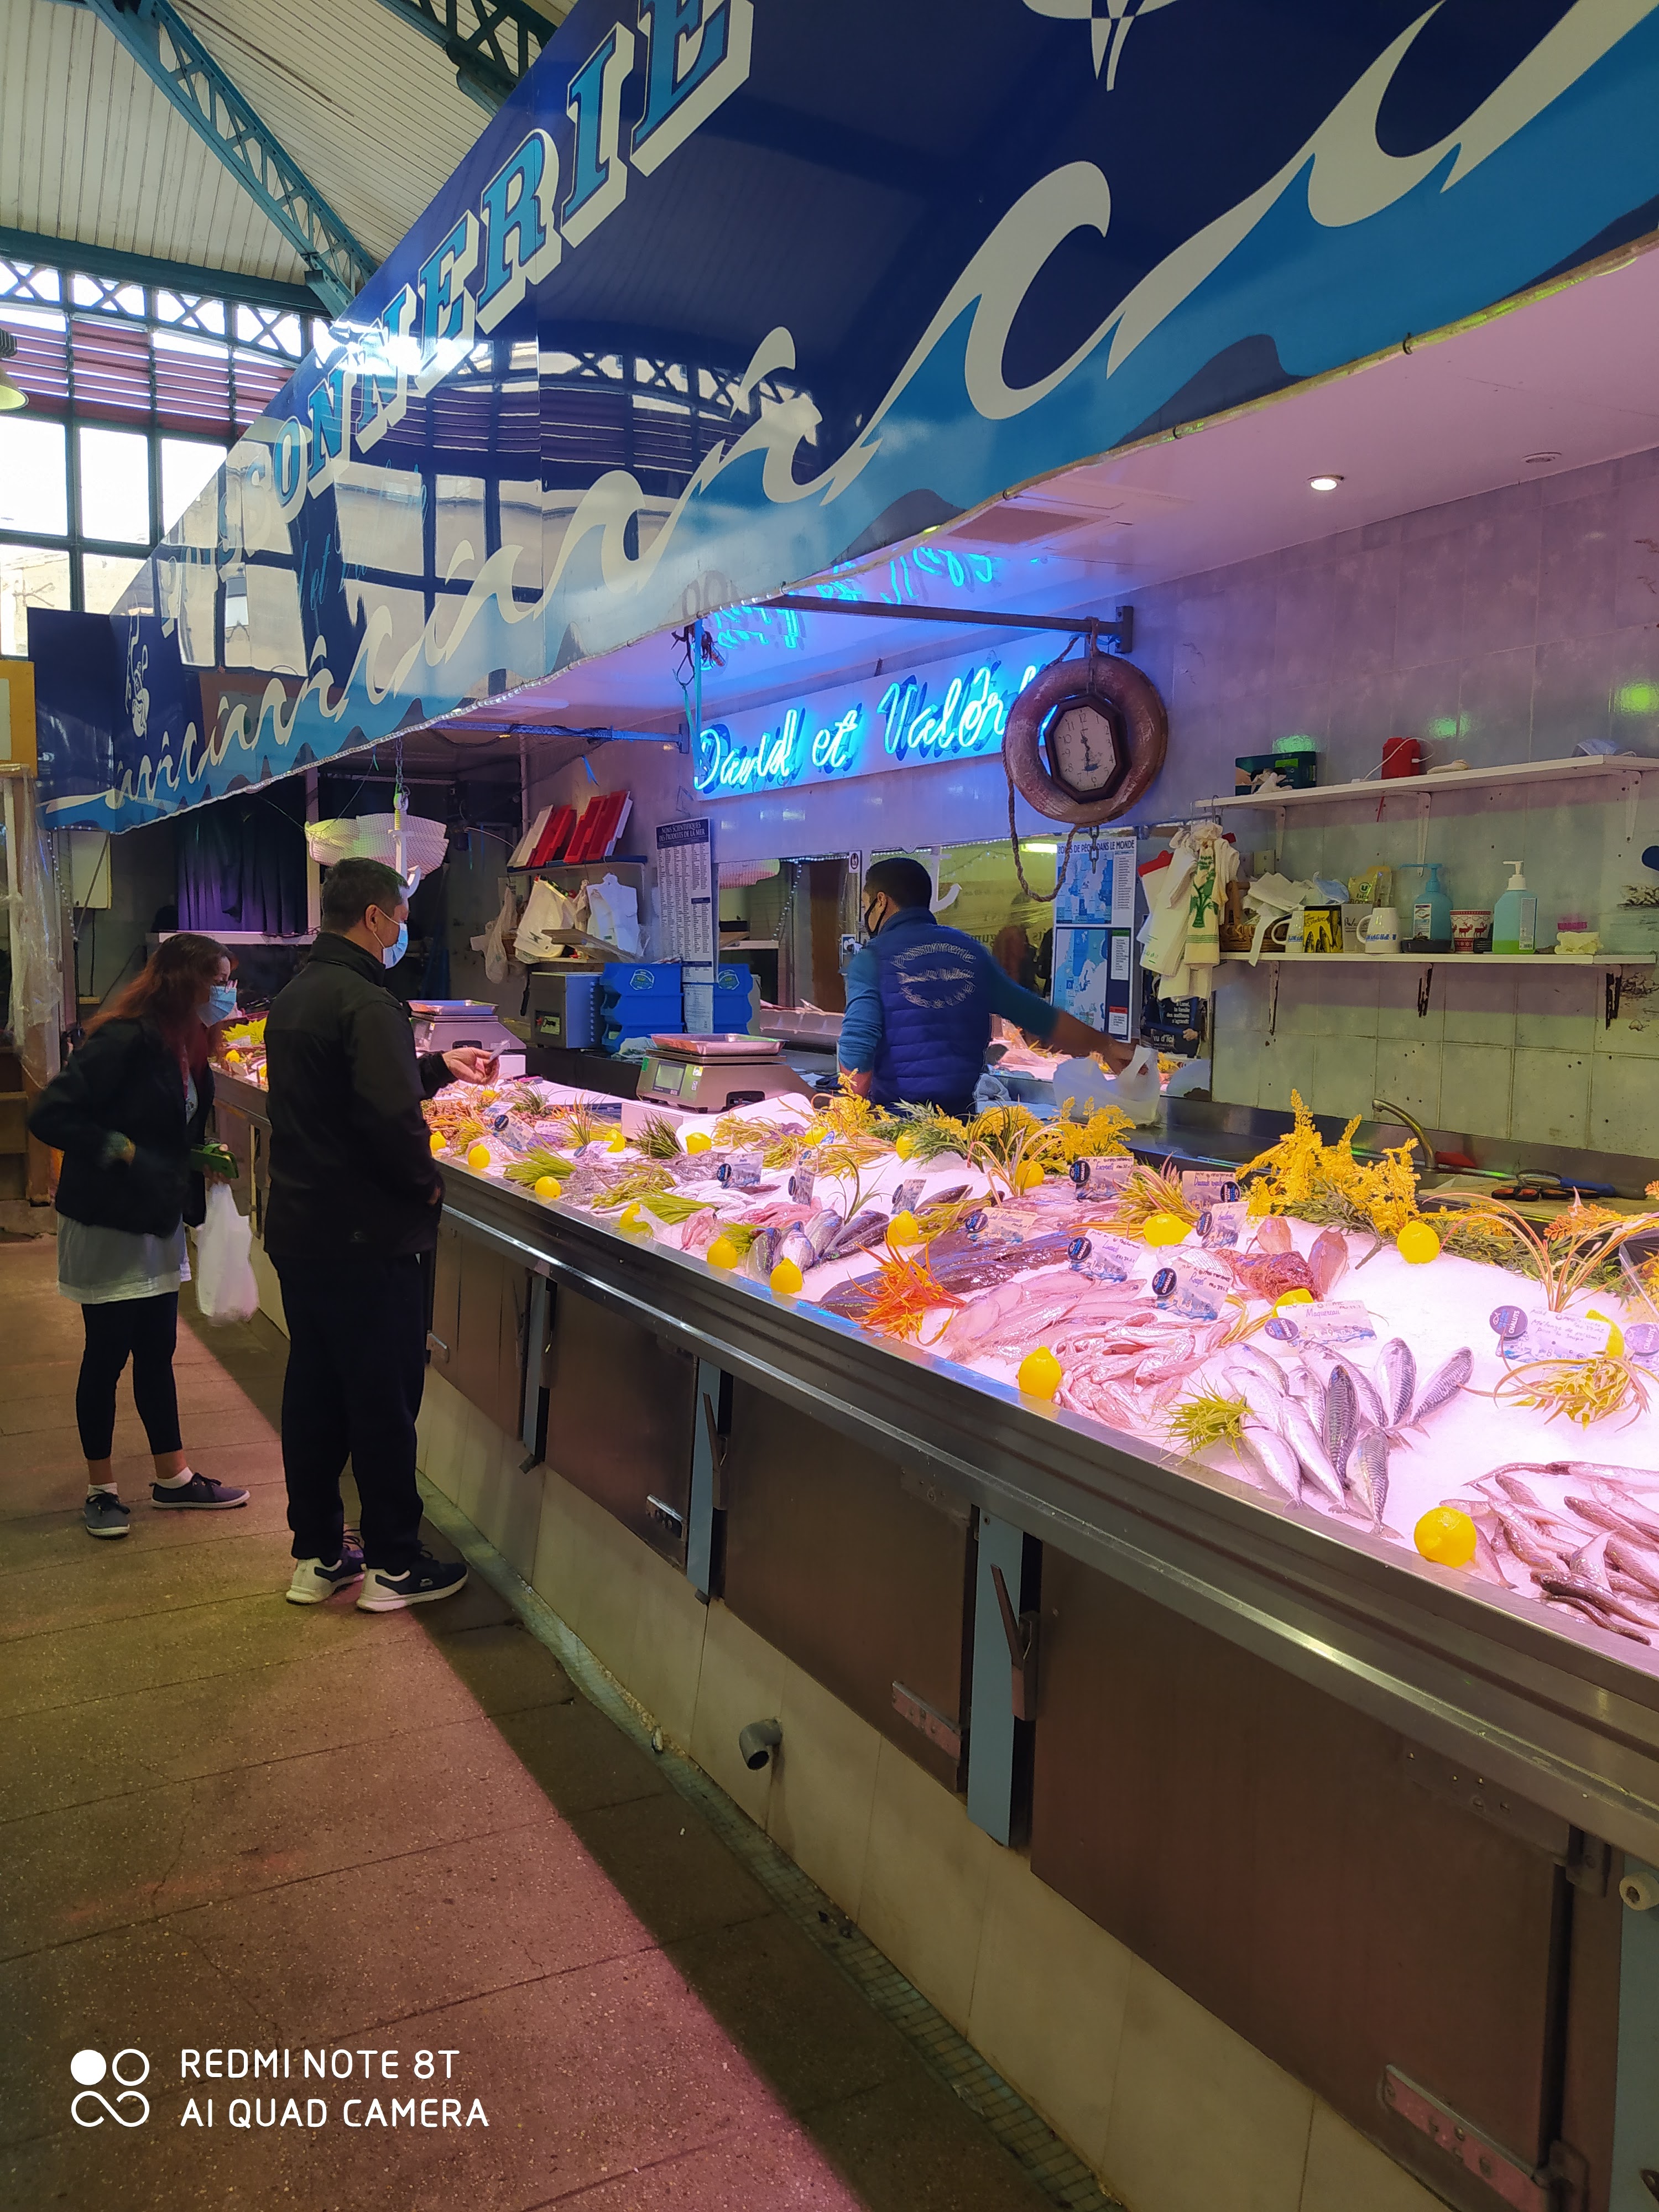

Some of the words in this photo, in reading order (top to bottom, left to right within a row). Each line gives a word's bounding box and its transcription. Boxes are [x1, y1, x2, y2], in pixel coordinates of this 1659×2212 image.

[693, 708, 799, 790] David
[812, 709, 857, 768] et
[1116, 839, 1135, 849] MONDE
[1306, 1308, 1341, 1318] Maquereau
[1508, 1310, 1521, 1334] CHALUTS
